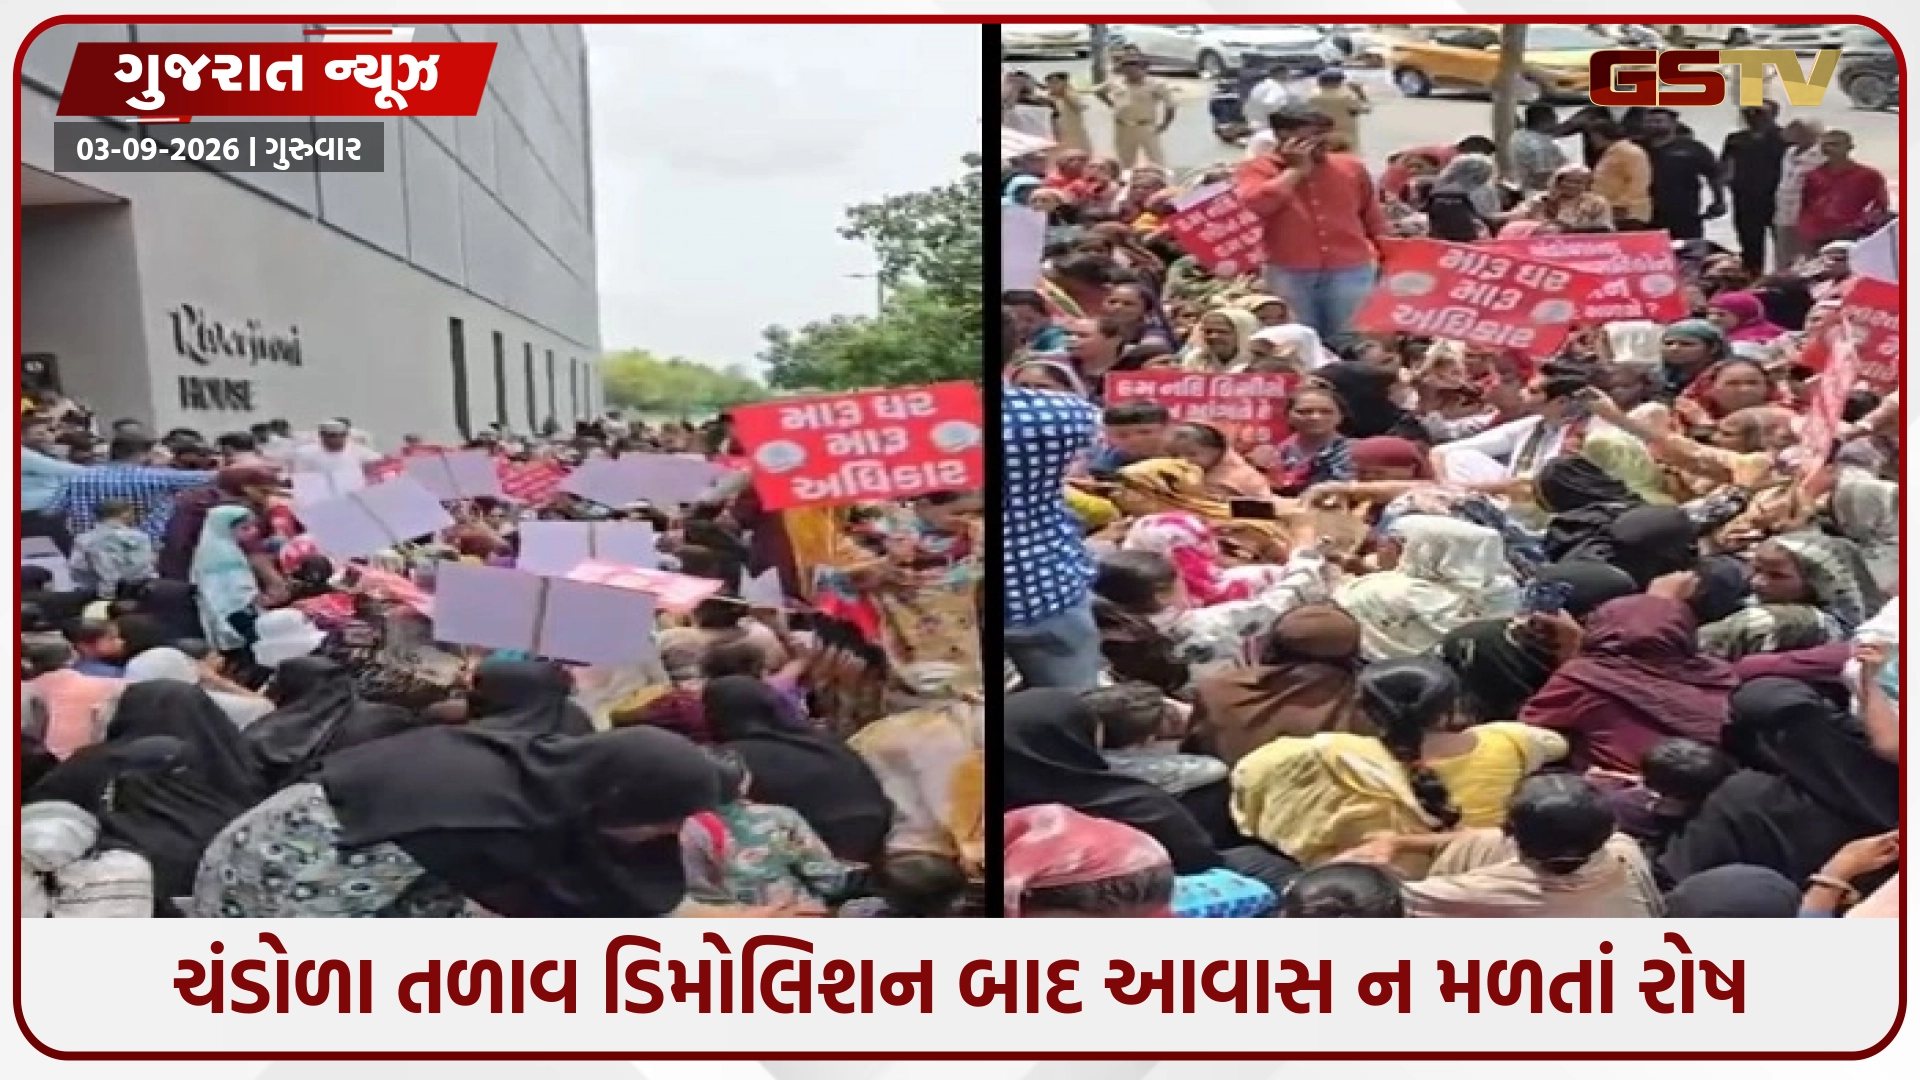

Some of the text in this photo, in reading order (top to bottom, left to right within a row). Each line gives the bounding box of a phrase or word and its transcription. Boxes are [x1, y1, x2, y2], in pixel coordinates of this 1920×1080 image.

[1391, 304, 1536, 348] અધિકાર
[872, 391, 938, 420] ઘર
[791, 458, 969, 500] અધિકાર
